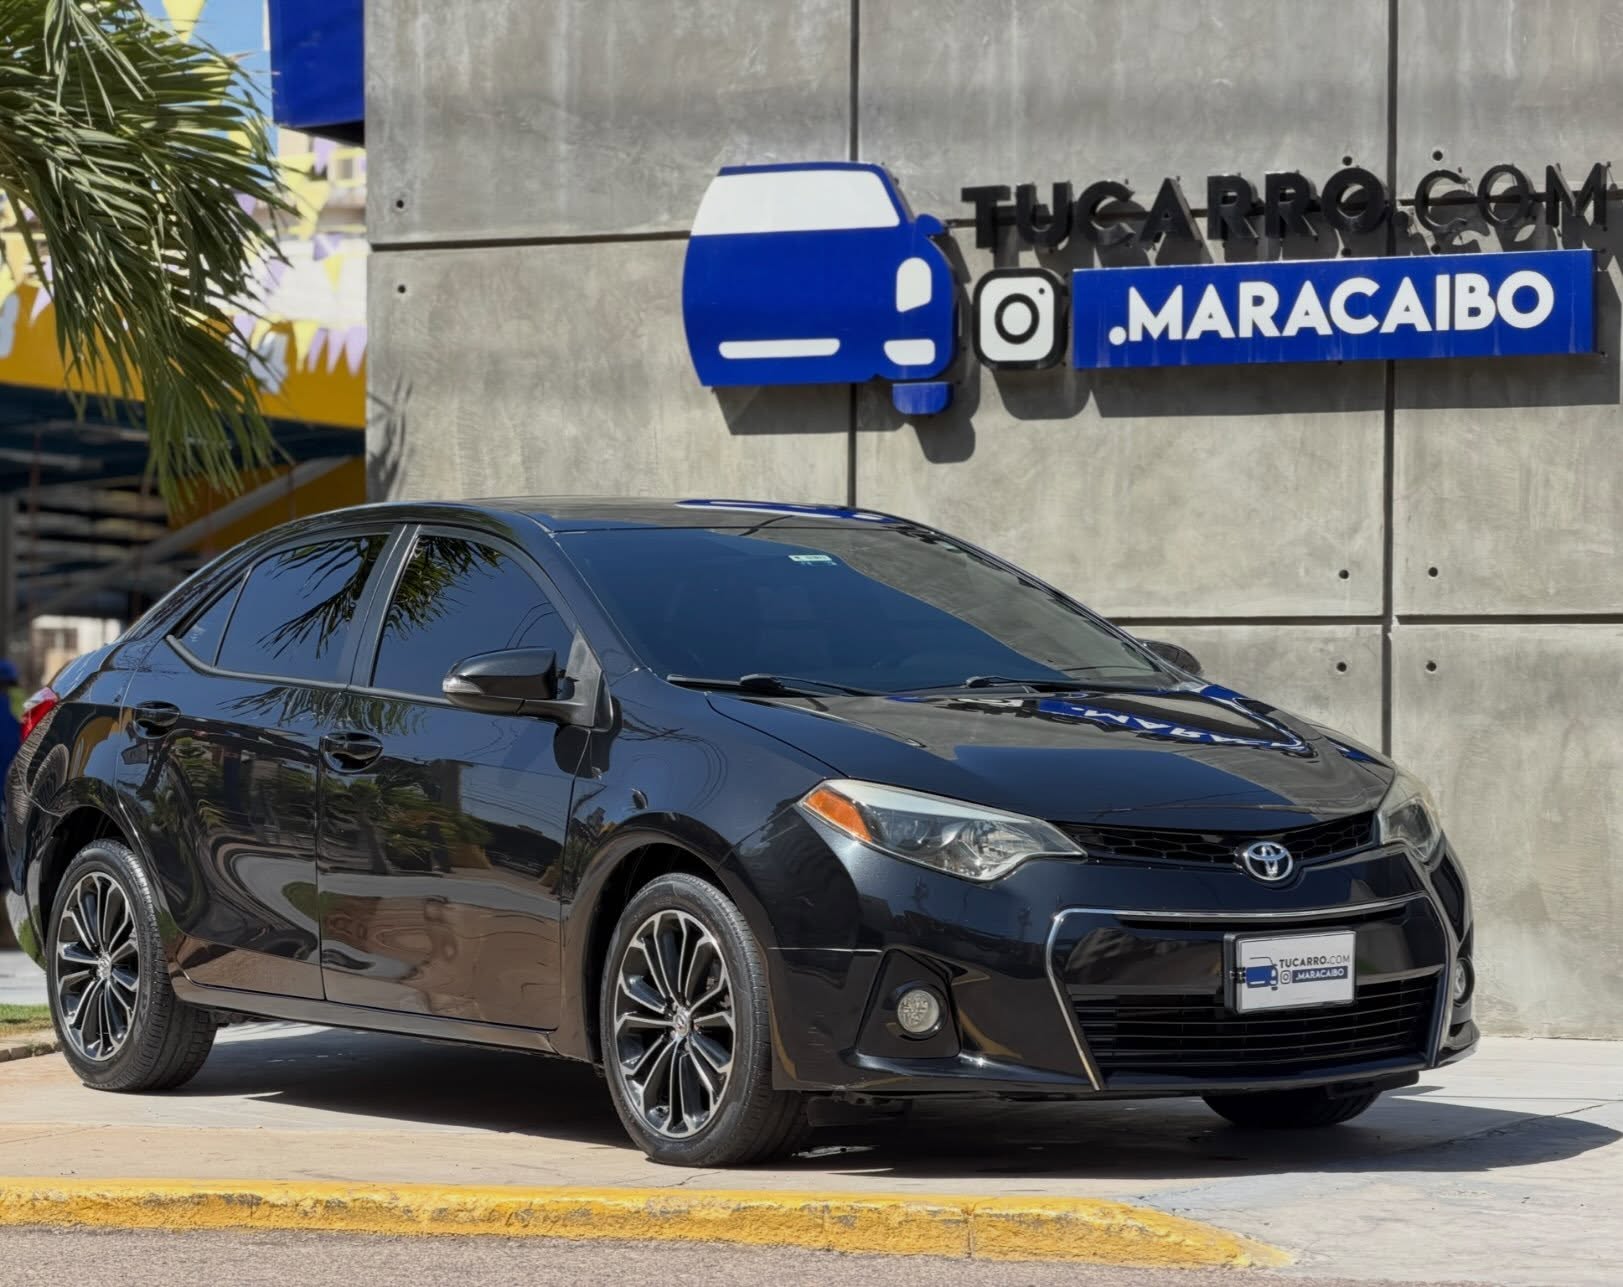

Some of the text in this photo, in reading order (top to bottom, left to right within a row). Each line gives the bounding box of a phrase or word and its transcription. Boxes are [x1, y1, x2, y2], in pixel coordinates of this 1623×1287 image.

[961, 162, 1607, 250] TUCARRO.COM
[1108, 270, 1555, 346] .MARACAIBO
[1279, 955, 1350, 969] TUCARRO.COM
